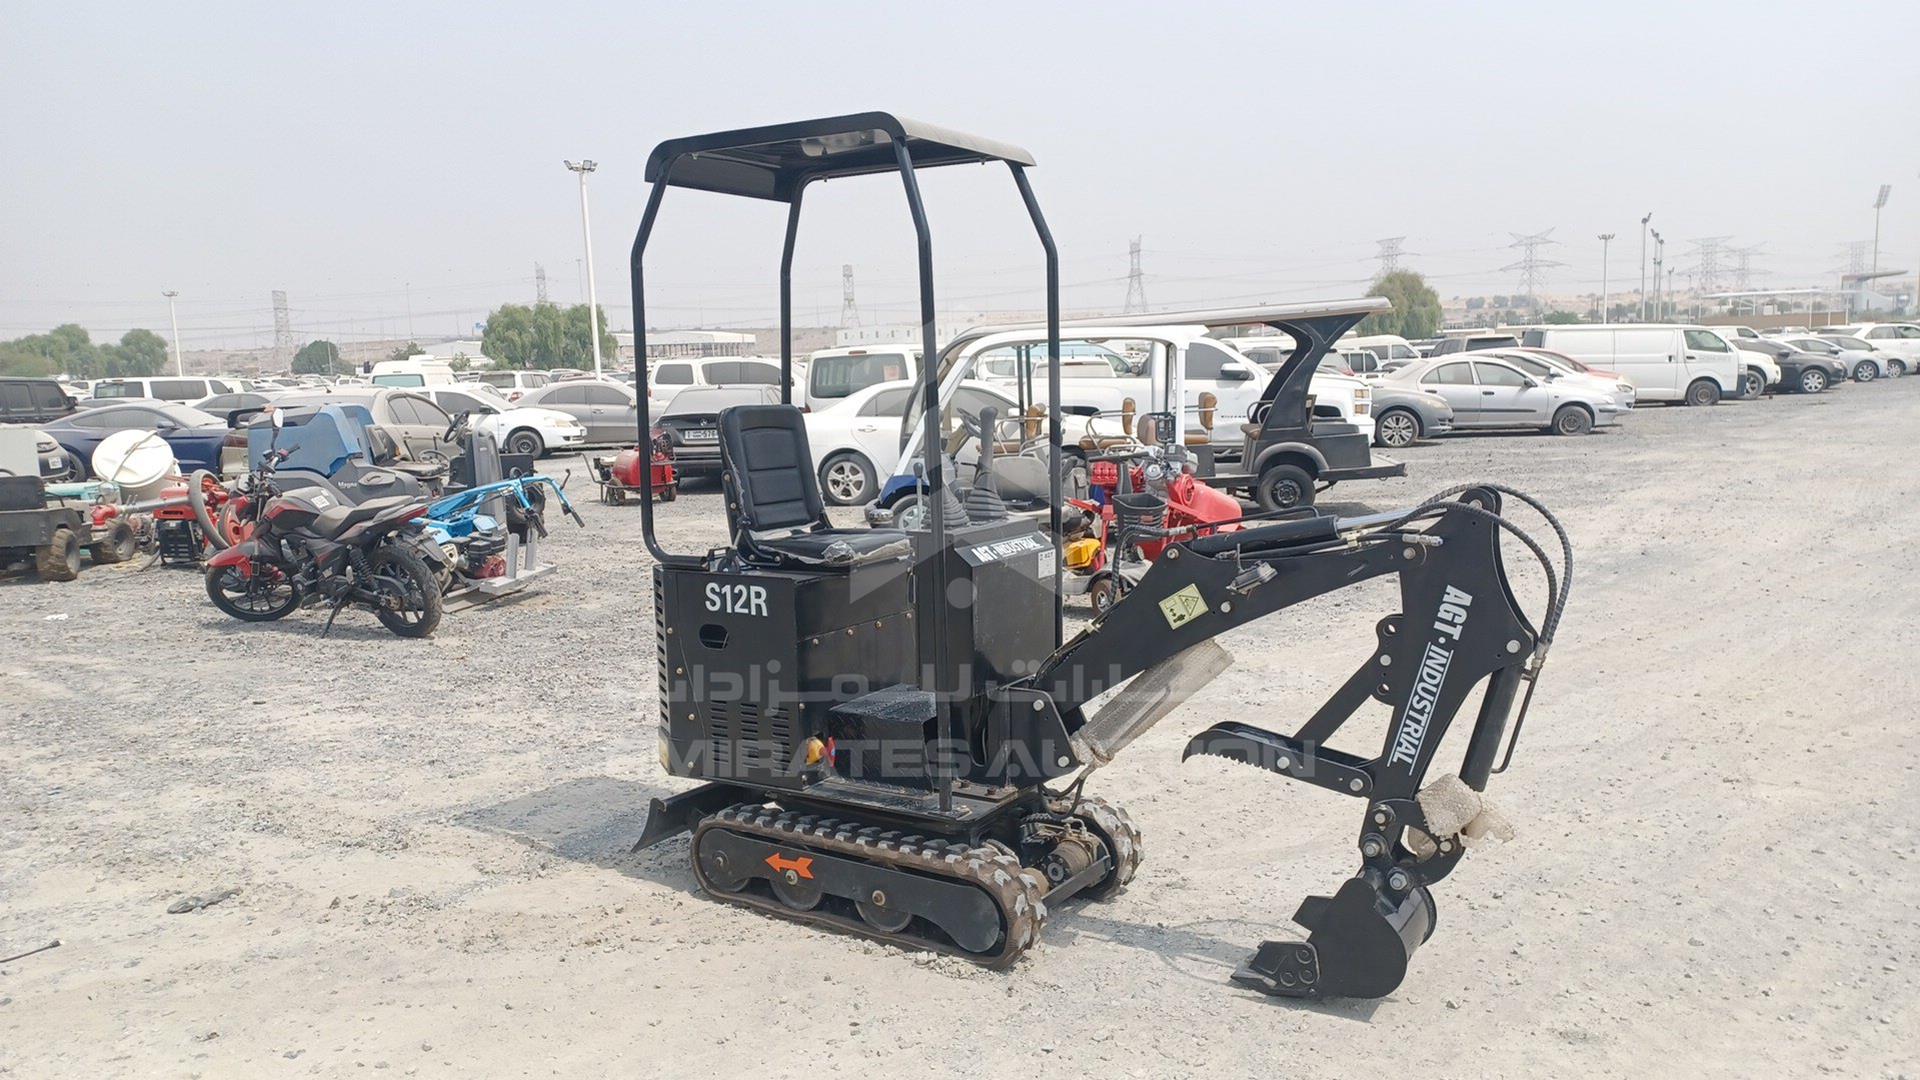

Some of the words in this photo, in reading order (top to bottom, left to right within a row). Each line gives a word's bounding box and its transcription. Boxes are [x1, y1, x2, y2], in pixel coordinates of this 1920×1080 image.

[971, 546, 998, 563] AGT
[705, 582, 768, 617] S12R
[1433, 584, 1473, 641] AGT
[1392, 644, 1450, 765] INDUSTRIAL
